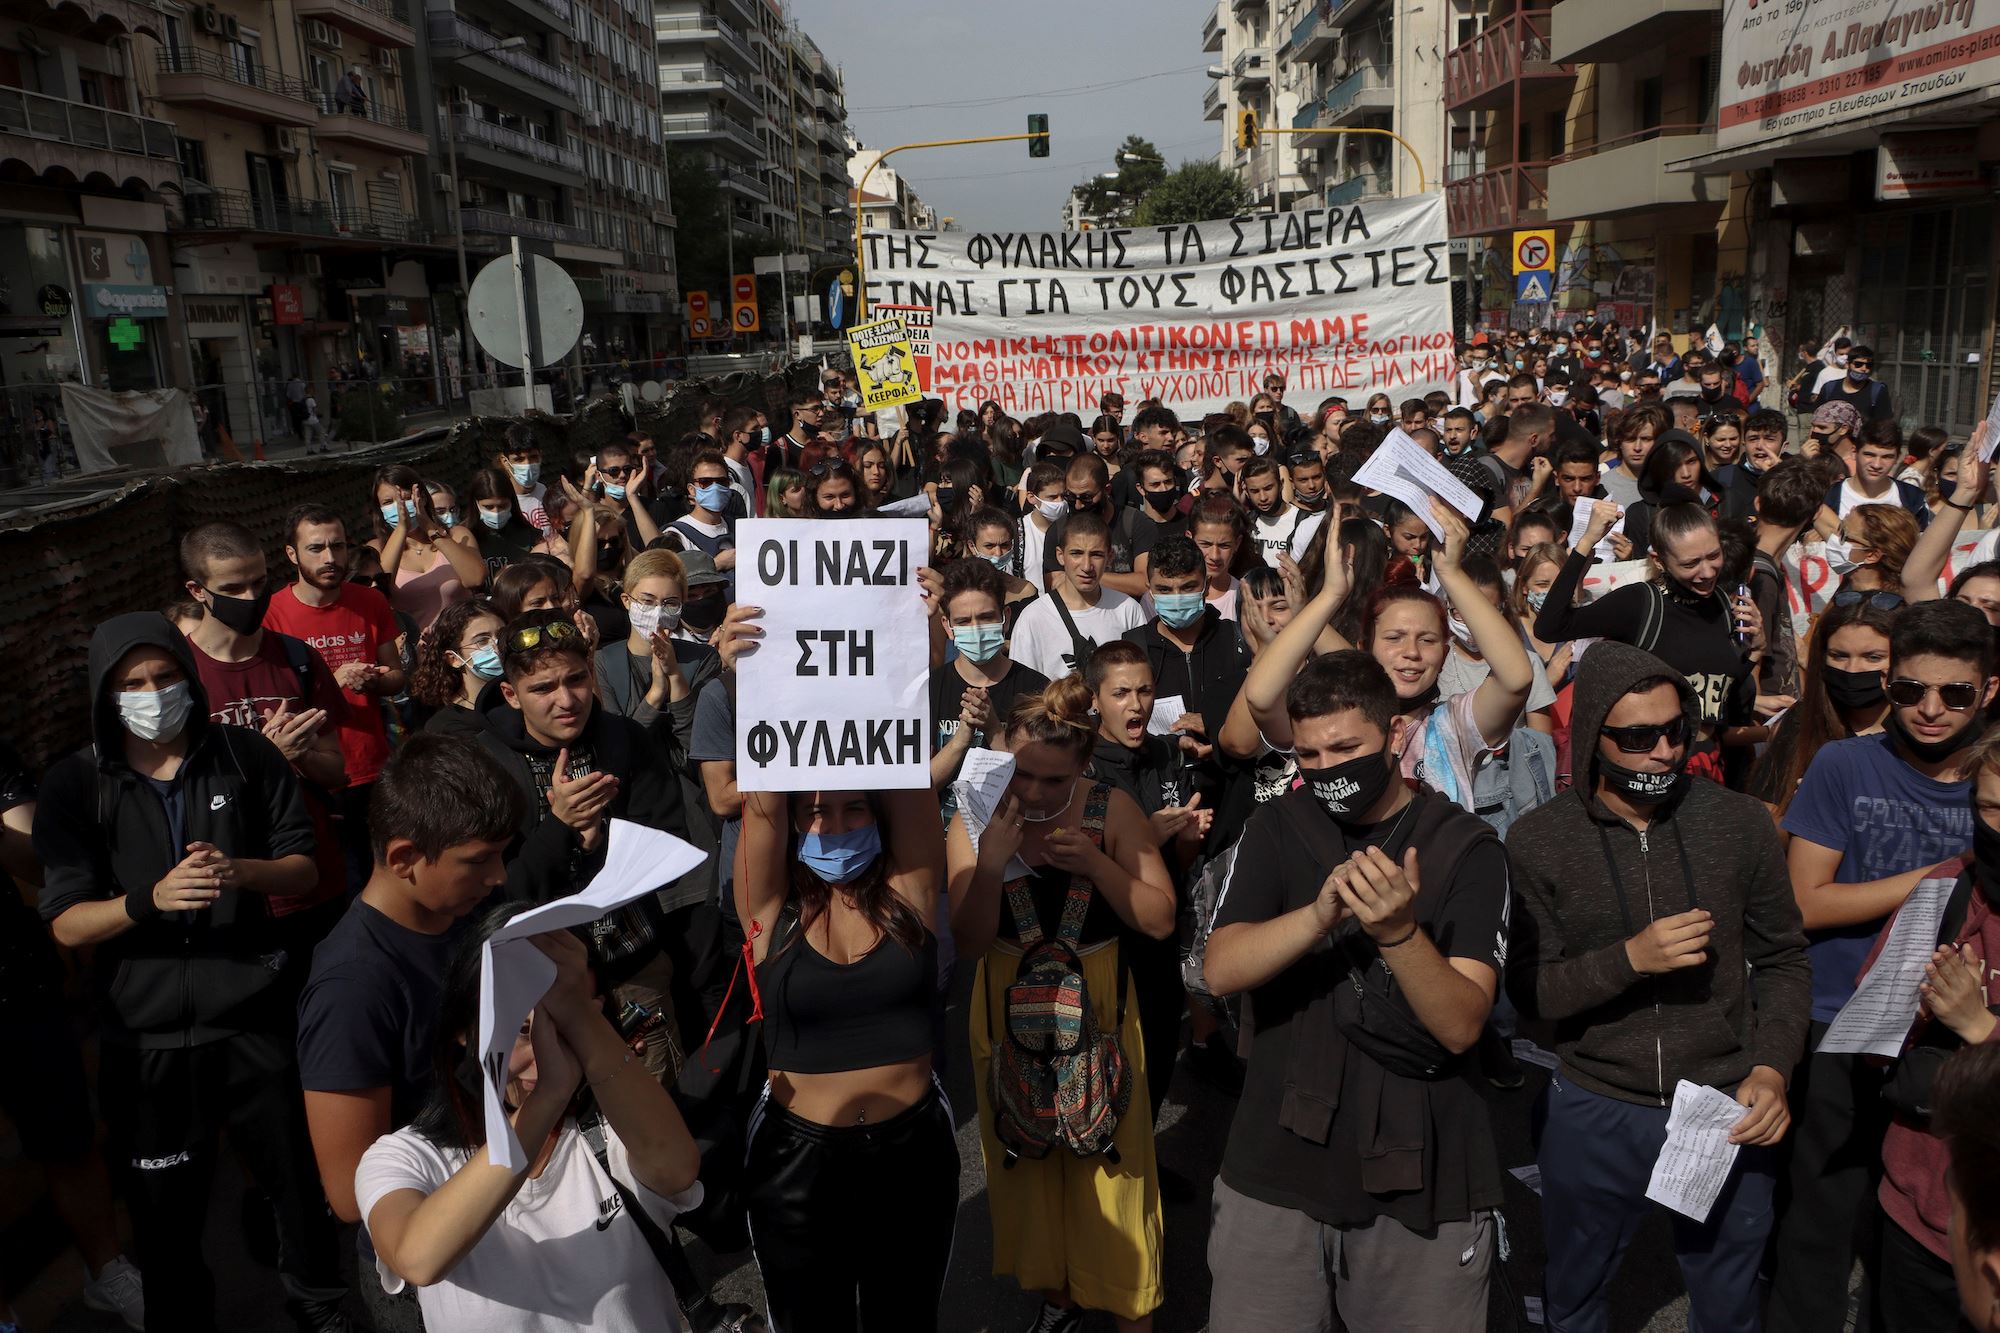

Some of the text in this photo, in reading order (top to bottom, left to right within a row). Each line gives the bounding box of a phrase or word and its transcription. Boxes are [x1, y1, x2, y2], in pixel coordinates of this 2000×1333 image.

[1767, 9, 1779, 21] το
[1737, 39, 1813, 90] Φωτιάδη
[1818, 79, 1841, 95] 2310
[1829, 89, 1896, 115] Ελευθέρων
[1900, 71, 1965, 98] Σπουδών
[861, 205, 1371, 270] ΤΗΣ ΦΥΛΑΚΗΣ ΤΑ ΣΙΔΕΡΑ
[998, 278, 1070, 318] ΓΙΑ
[1093, 272, 1198, 310] ΤΟΥΣ
[1219, 242, 1448, 305] ΦΑΣΙΣΤΕΣ
[852, 320, 899, 342] ΠΟΤΕ ΞΑΝΑ
[861, 332, 905, 349] ΦΑΣΙΣΜΟΣ
[1290, 313, 1369, 348] ΜΜΕ
[934, 352, 1127, 385] ΜΑΘΗΜΑΤΙΚΟΥ
[867, 386, 908, 404] ΚΕΕΡΦΑ
[757, 538, 908, 587] ΟΙ ΝΑΖΙ
[796, 629, 874, 677] ΣΤΗ
[747, 718, 921, 768] ΦΥΛΑΚΗ
[131, 1150, 191, 1170] LEGEA
[598, 1192, 621, 1216] NIKE
